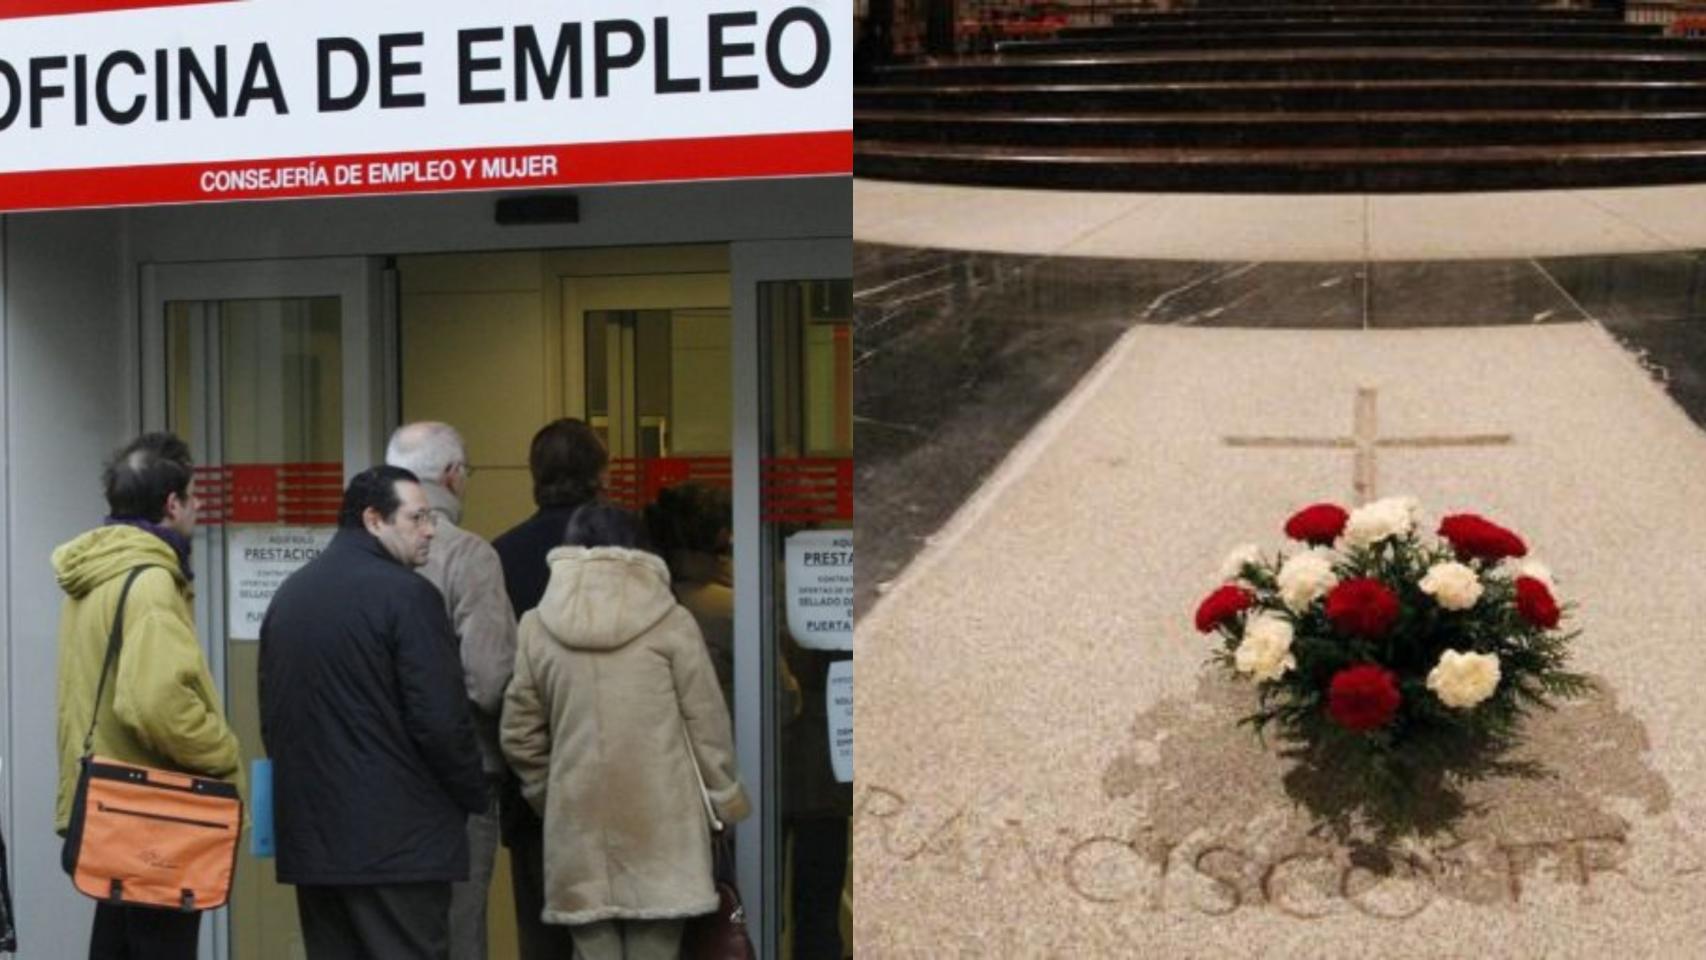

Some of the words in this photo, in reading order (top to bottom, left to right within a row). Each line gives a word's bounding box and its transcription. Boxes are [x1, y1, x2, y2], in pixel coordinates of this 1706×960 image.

[317, 31, 426, 113] DE
[458, 6, 831, 105] EMPLEO
[200, 161, 329, 192] CONSEJERÍA
[334, 164, 363, 185] DE
[368, 160, 456, 185] EMPLEO
[461, 158, 476, 180] Y
[481, 154, 558, 179] MUJER
